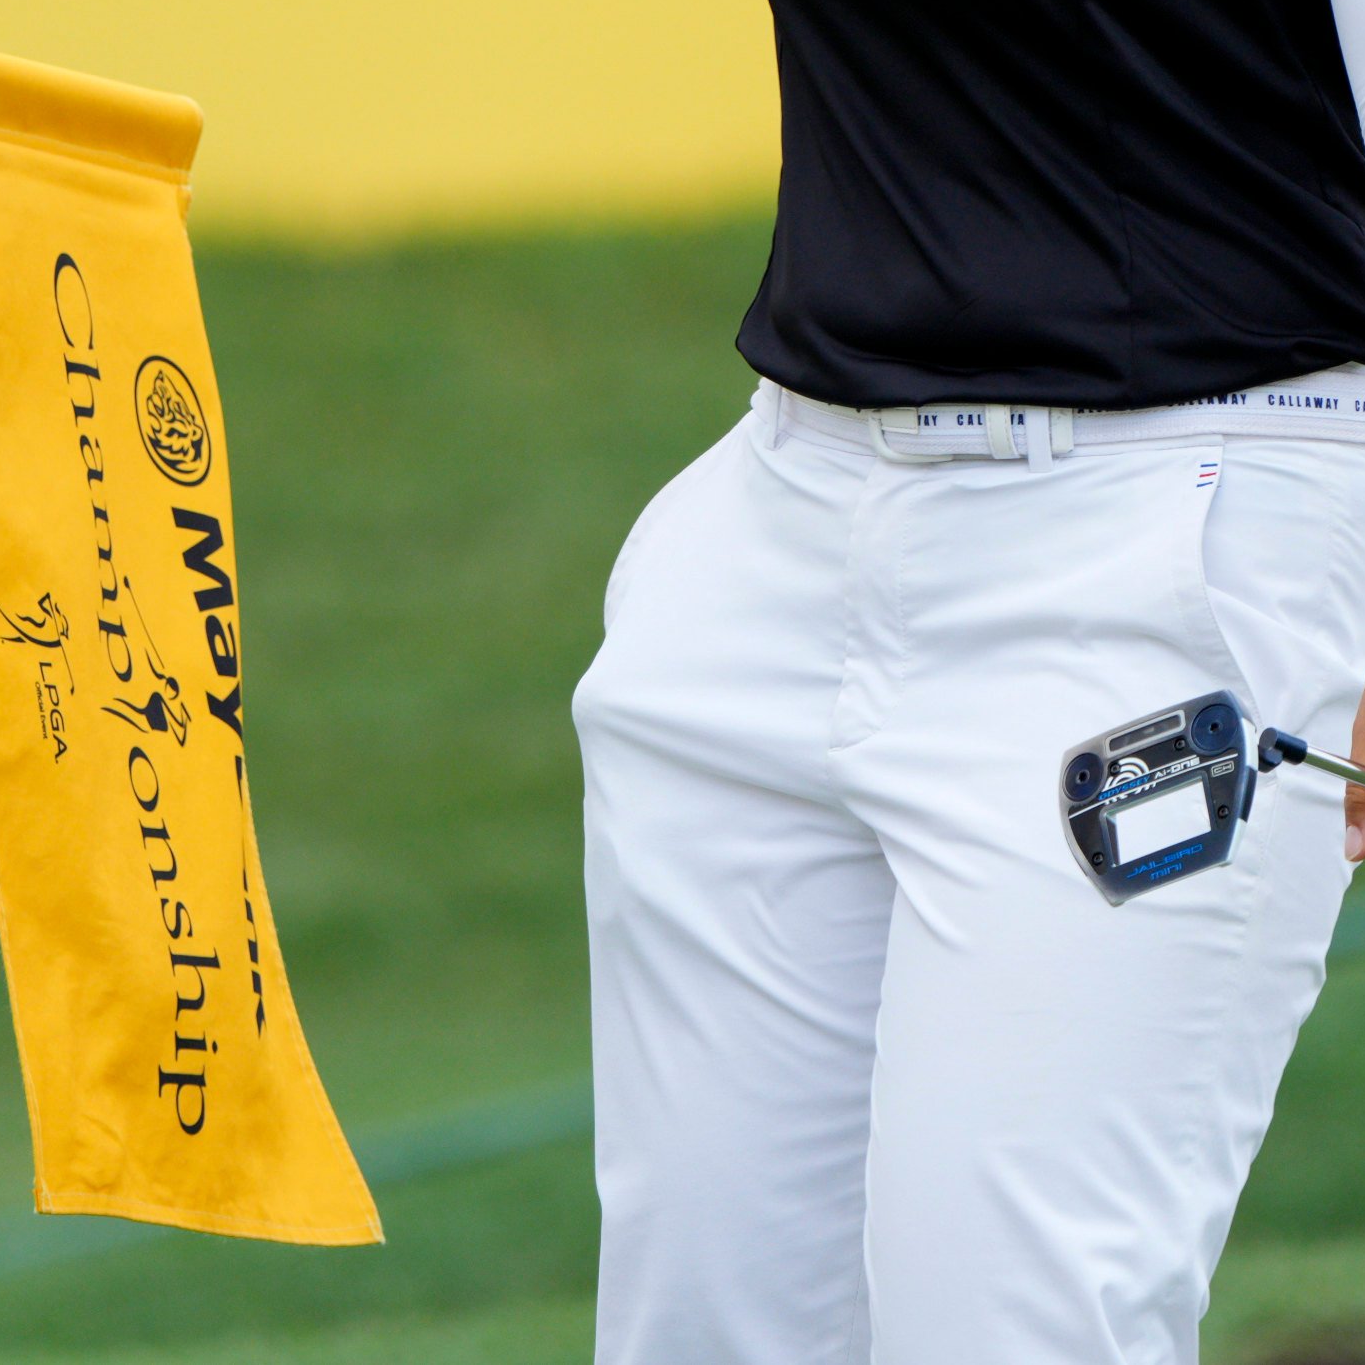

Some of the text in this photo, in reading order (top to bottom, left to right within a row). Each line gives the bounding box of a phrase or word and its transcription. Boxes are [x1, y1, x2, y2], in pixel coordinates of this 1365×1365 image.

[1267, 393, 1339, 411] CALLAWAY
[38, 661, 68, 760] LPGA
[1097, 775, 1152, 801] ODYSSEY
[1126, 843, 1203, 879] JAILBIRD
